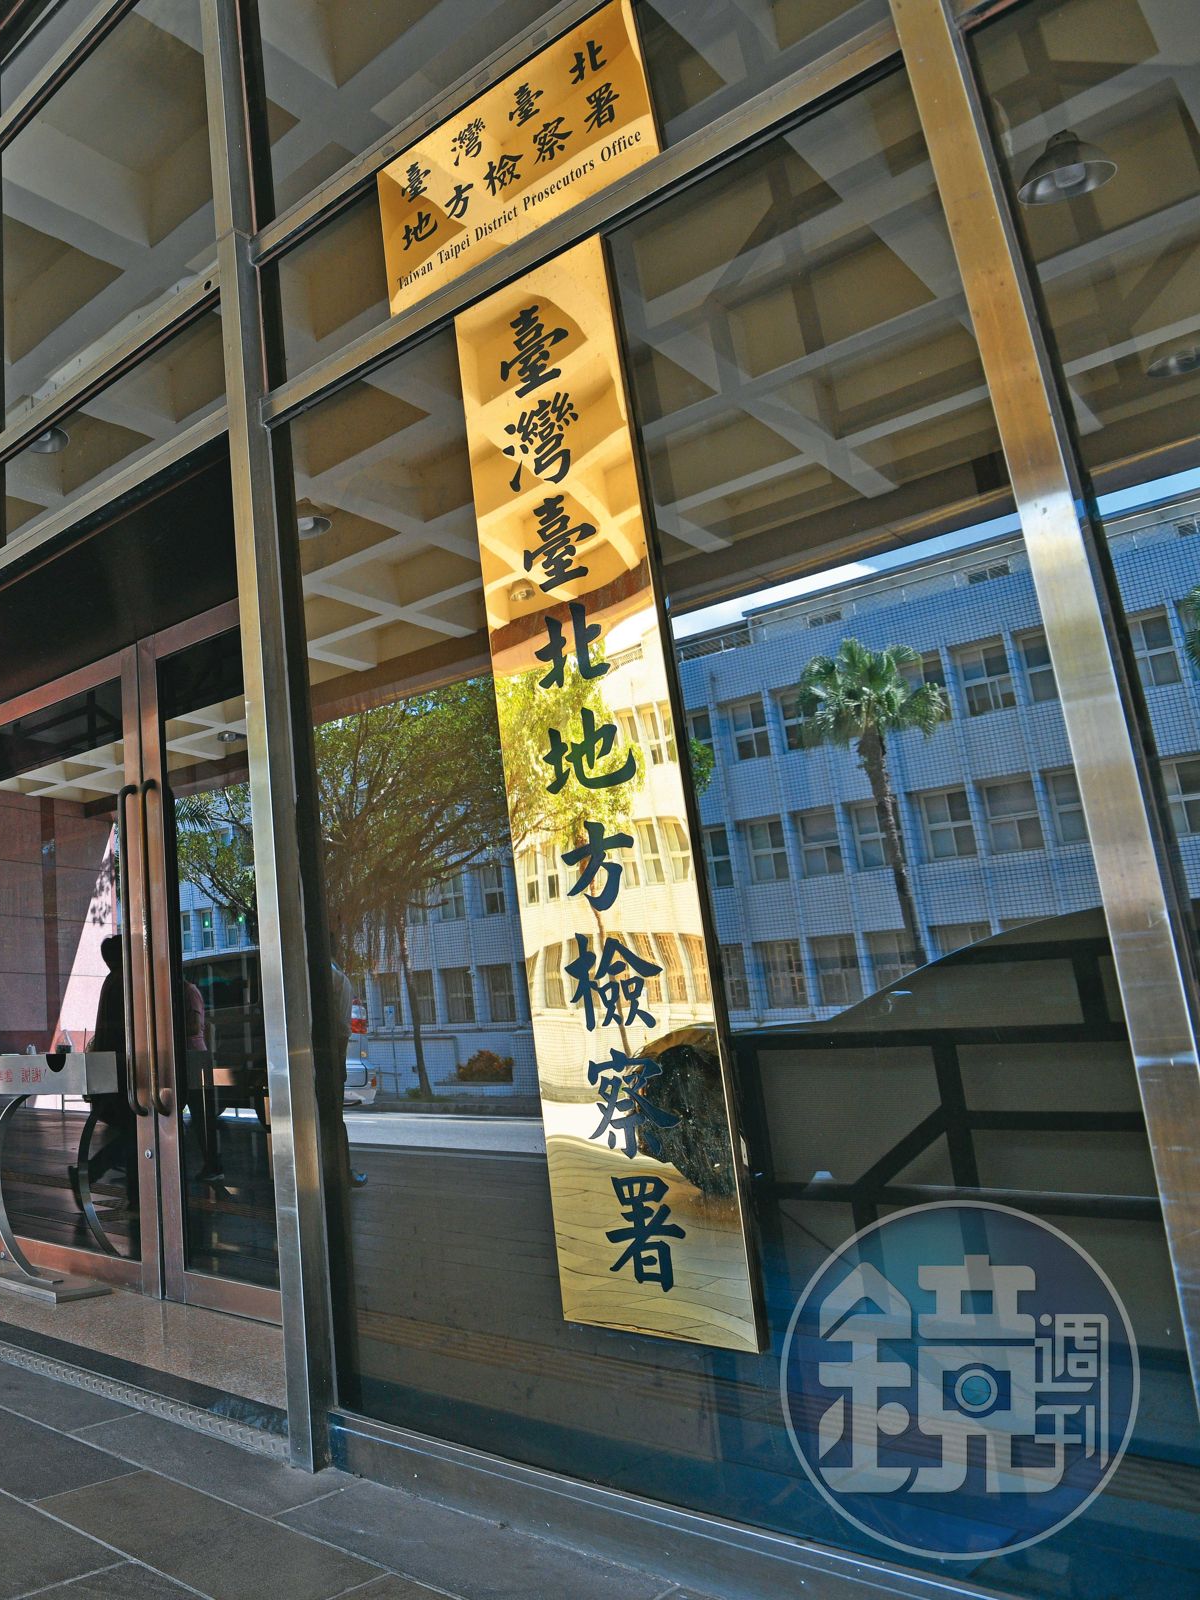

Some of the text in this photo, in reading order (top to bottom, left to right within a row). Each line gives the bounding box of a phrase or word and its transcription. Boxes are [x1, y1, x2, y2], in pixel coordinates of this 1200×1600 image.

[400, 40, 607, 203] 臺灣臺北
[402, 82, 619, 250] 地方檢察署
[397, 131, 642, 289] Taiwan Taipei District Prosecutors Office
[500, 304, 686, 1293] 臺灣臺北地方檢察署
